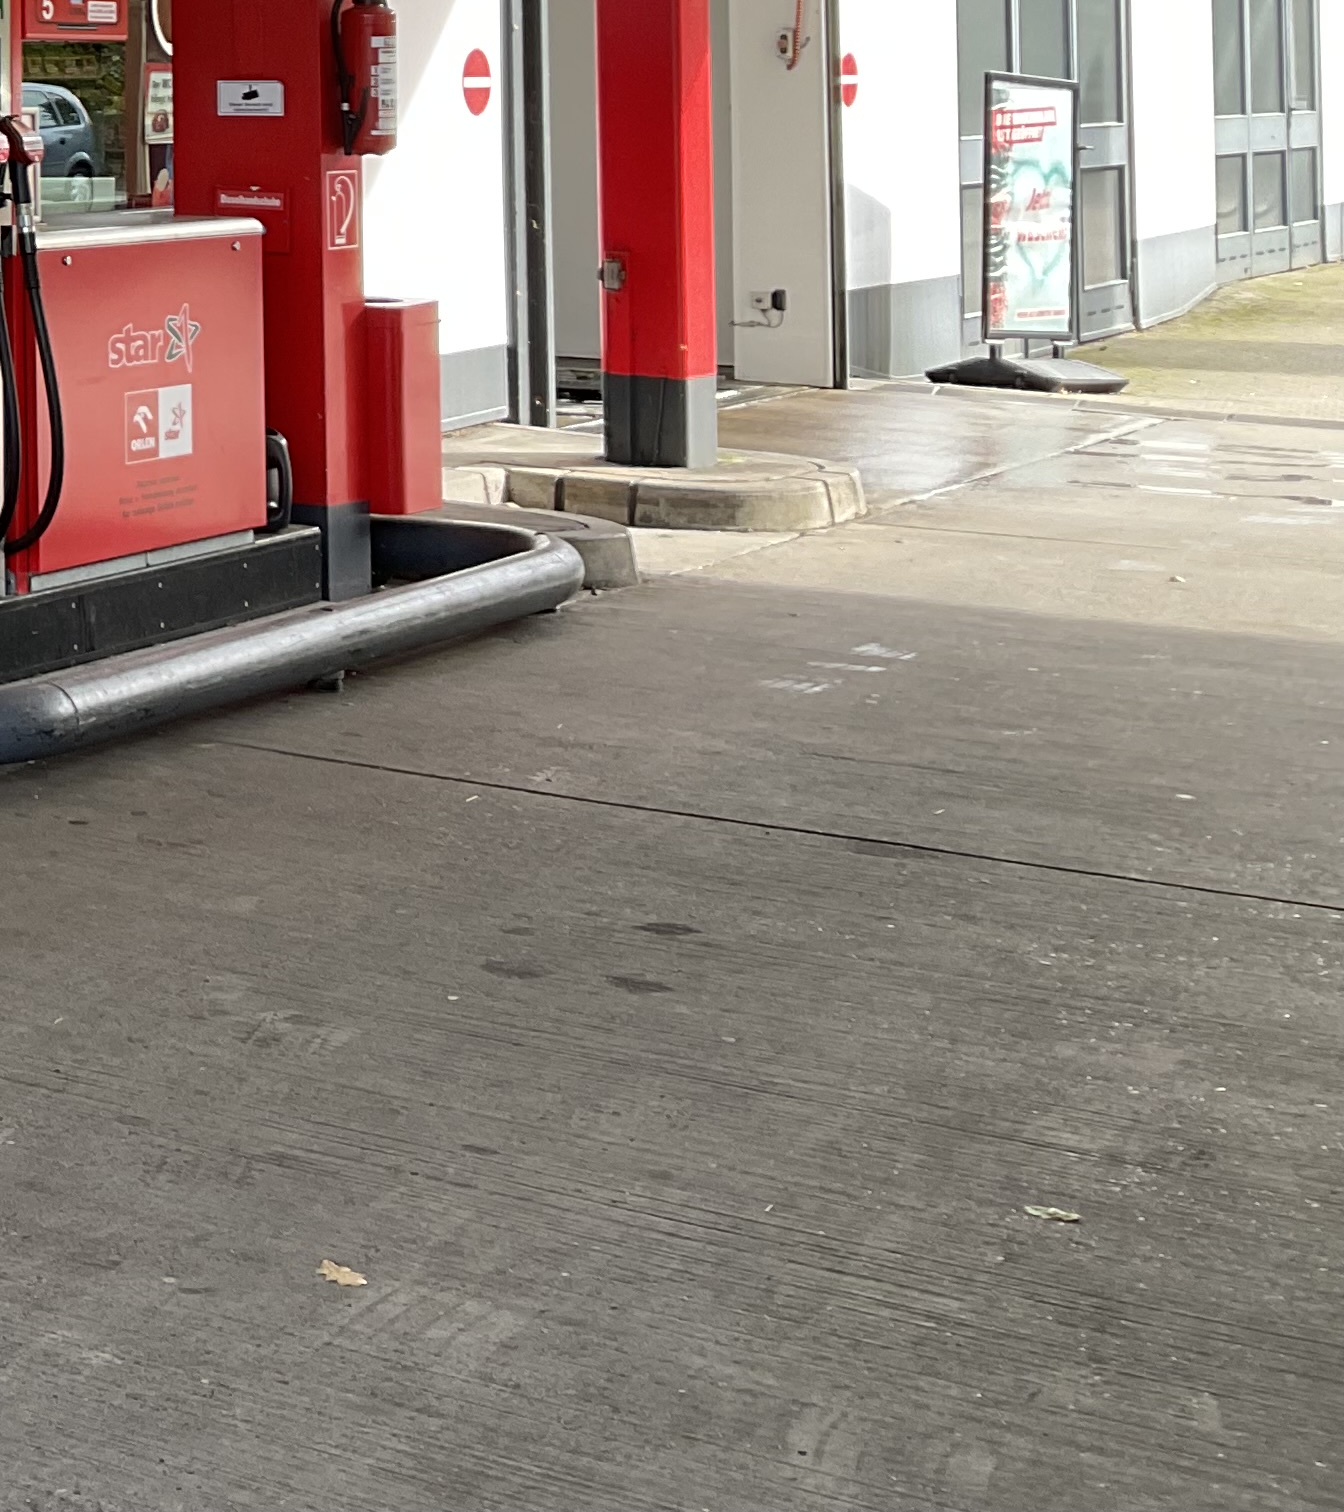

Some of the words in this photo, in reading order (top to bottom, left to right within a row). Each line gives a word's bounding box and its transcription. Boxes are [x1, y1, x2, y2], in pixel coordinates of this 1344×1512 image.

[108, 323, 164, 369] star
[164, 428, 181, 441] star
[130, 436, 156, 452] ORLEN
